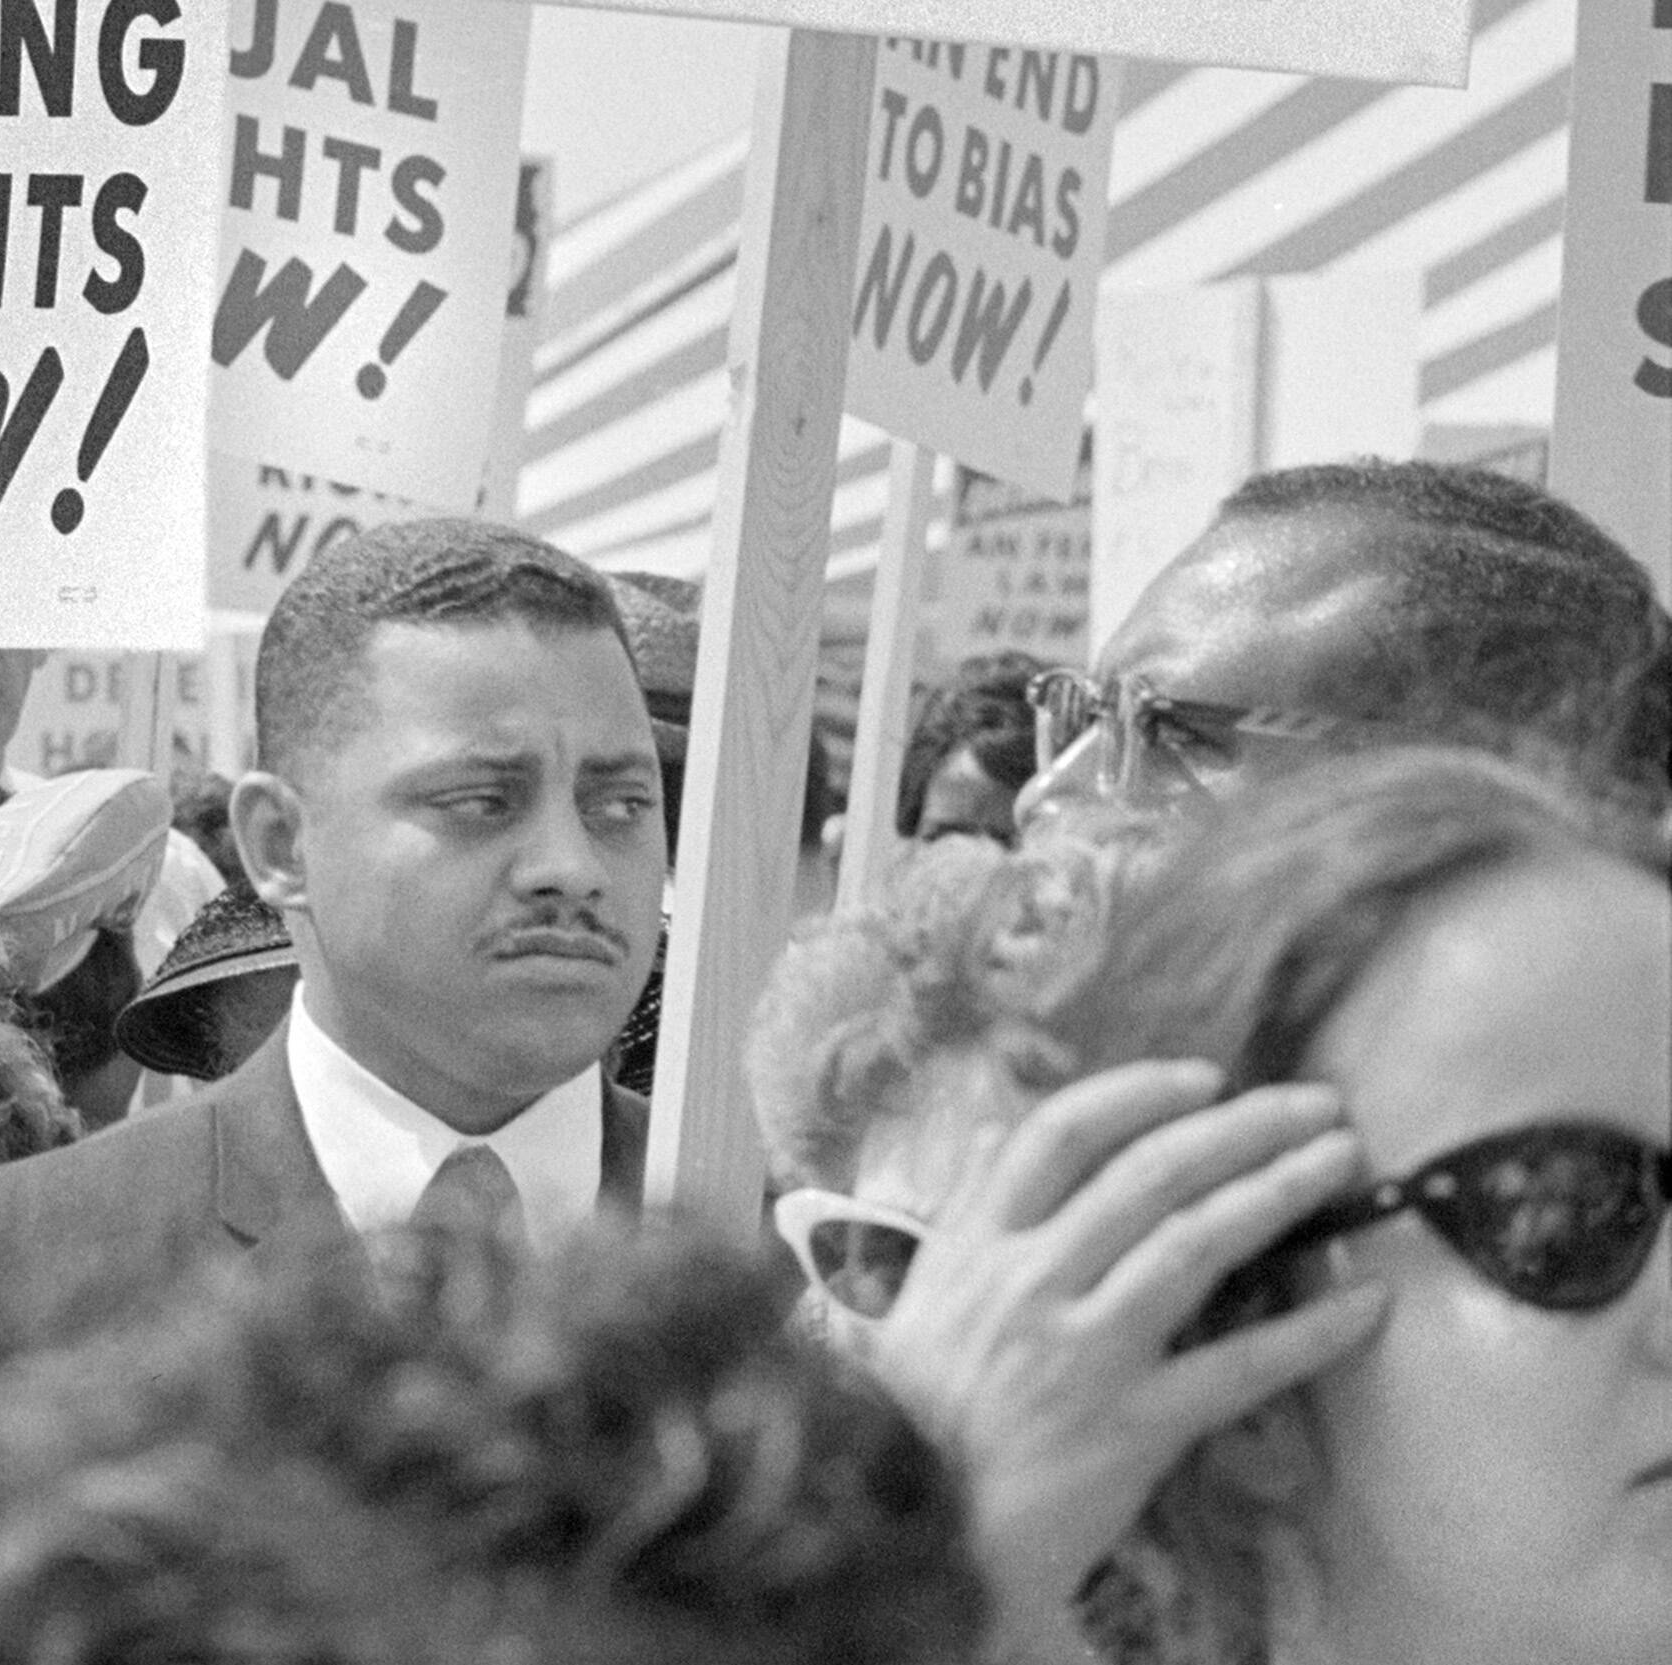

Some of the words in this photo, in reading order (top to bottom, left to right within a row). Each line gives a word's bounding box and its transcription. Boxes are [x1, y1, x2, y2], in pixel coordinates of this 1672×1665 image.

[879, 87, 945, 198] TO
[954, 124, 1083, 261] BIAS
[852, 222, 1072, 408] NOW!
